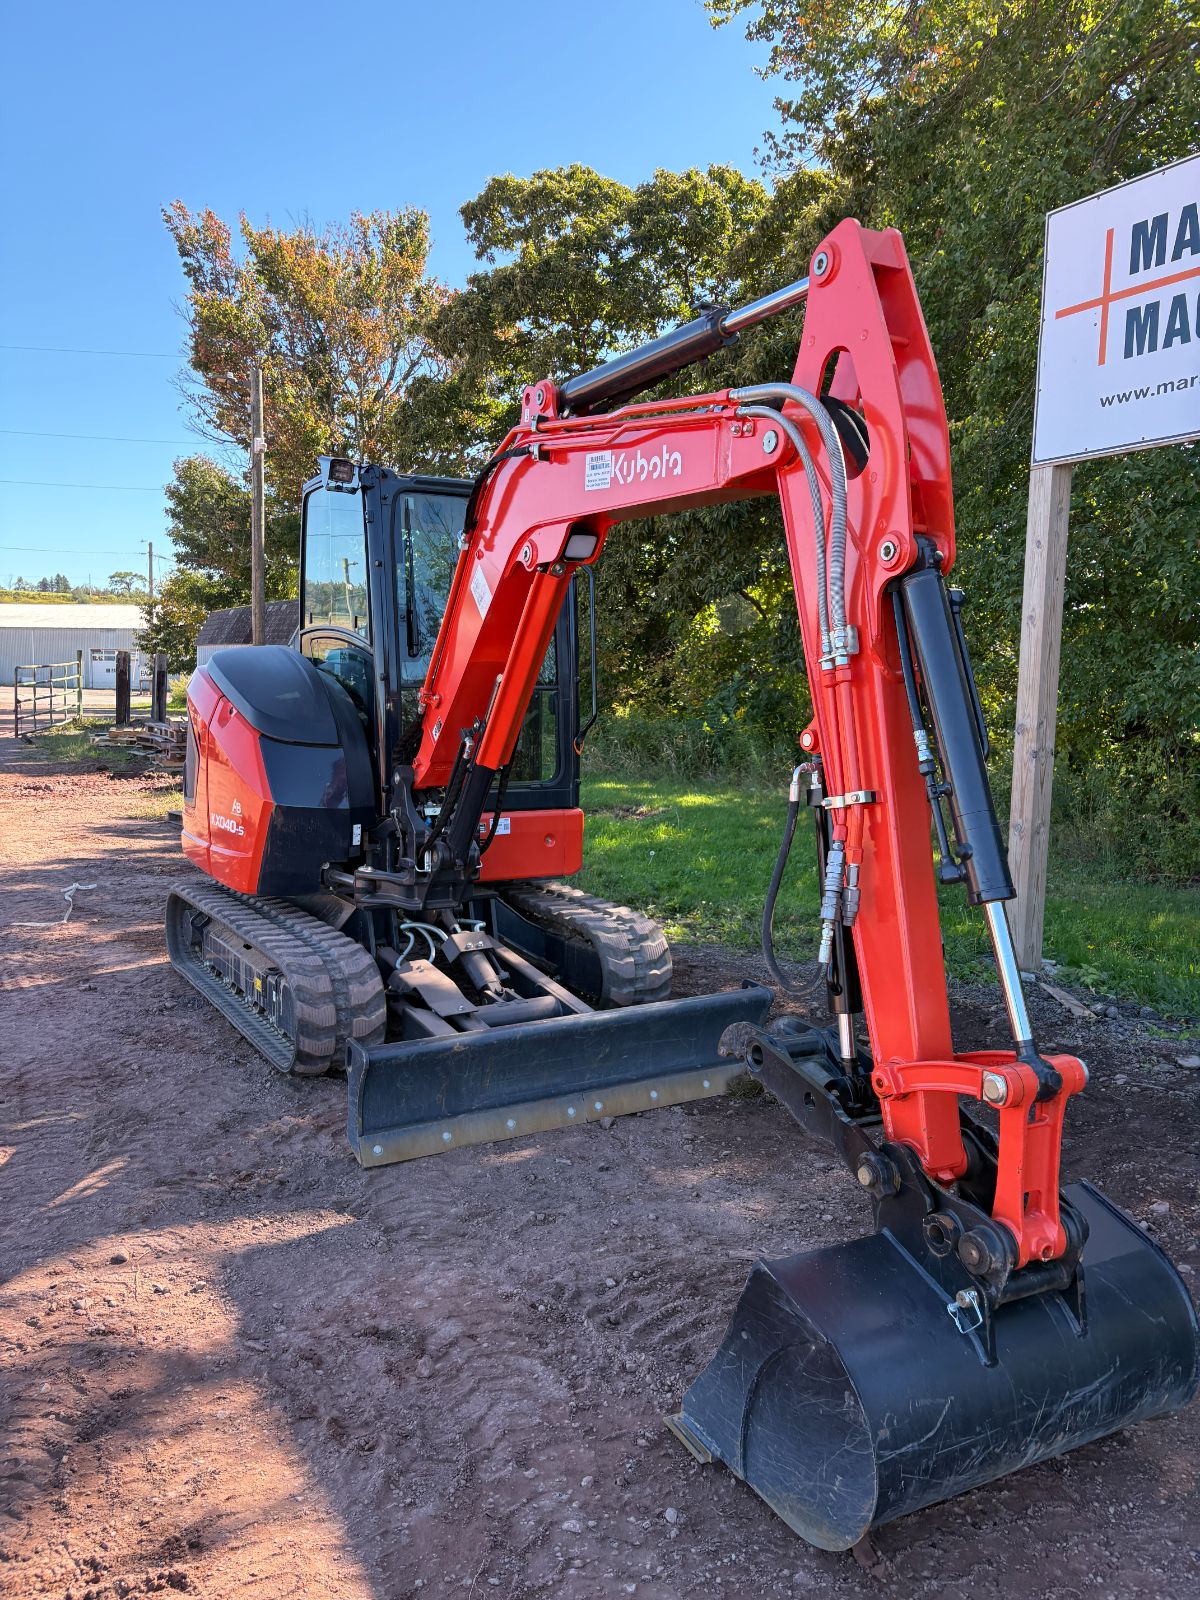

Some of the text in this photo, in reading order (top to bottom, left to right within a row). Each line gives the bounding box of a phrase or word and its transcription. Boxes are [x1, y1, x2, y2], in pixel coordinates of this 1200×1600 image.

[1129, 202, 1200, 275] MA
[1123, 292, 1200, 360] MA
[1099, 375, 1200, 408] www.mar
[611, 445, 681, 484] Kubota
